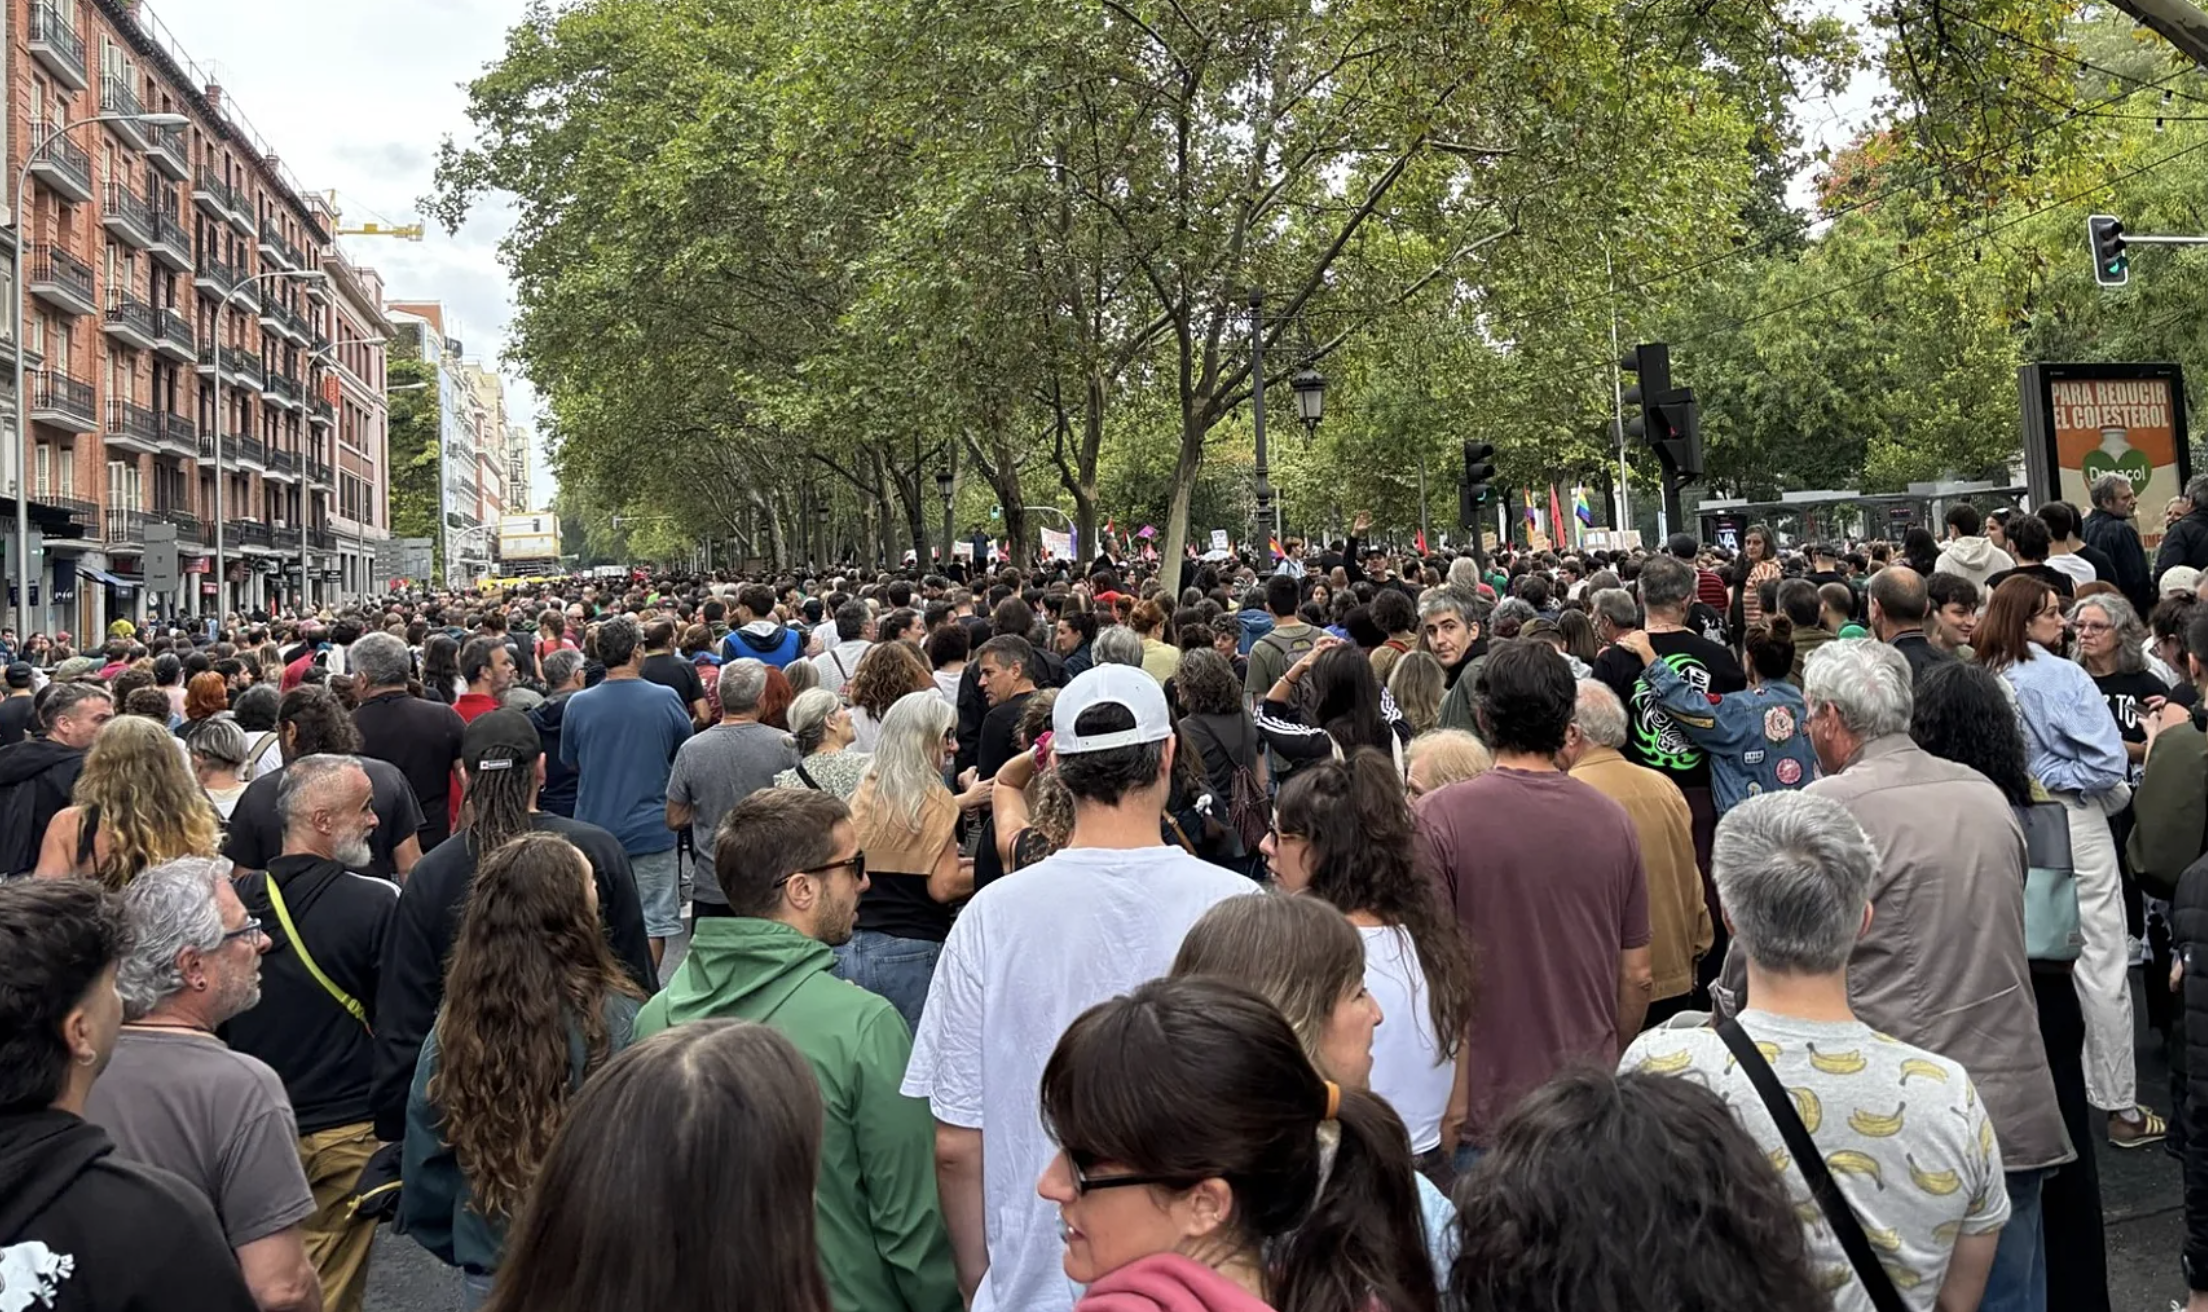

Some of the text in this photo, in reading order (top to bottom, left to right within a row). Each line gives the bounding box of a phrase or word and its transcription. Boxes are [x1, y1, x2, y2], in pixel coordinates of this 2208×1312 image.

[2051, 382, 2168, 406] PARA REDUCIR
[2053, 405, 2170, 430] EL COLESTEROL
